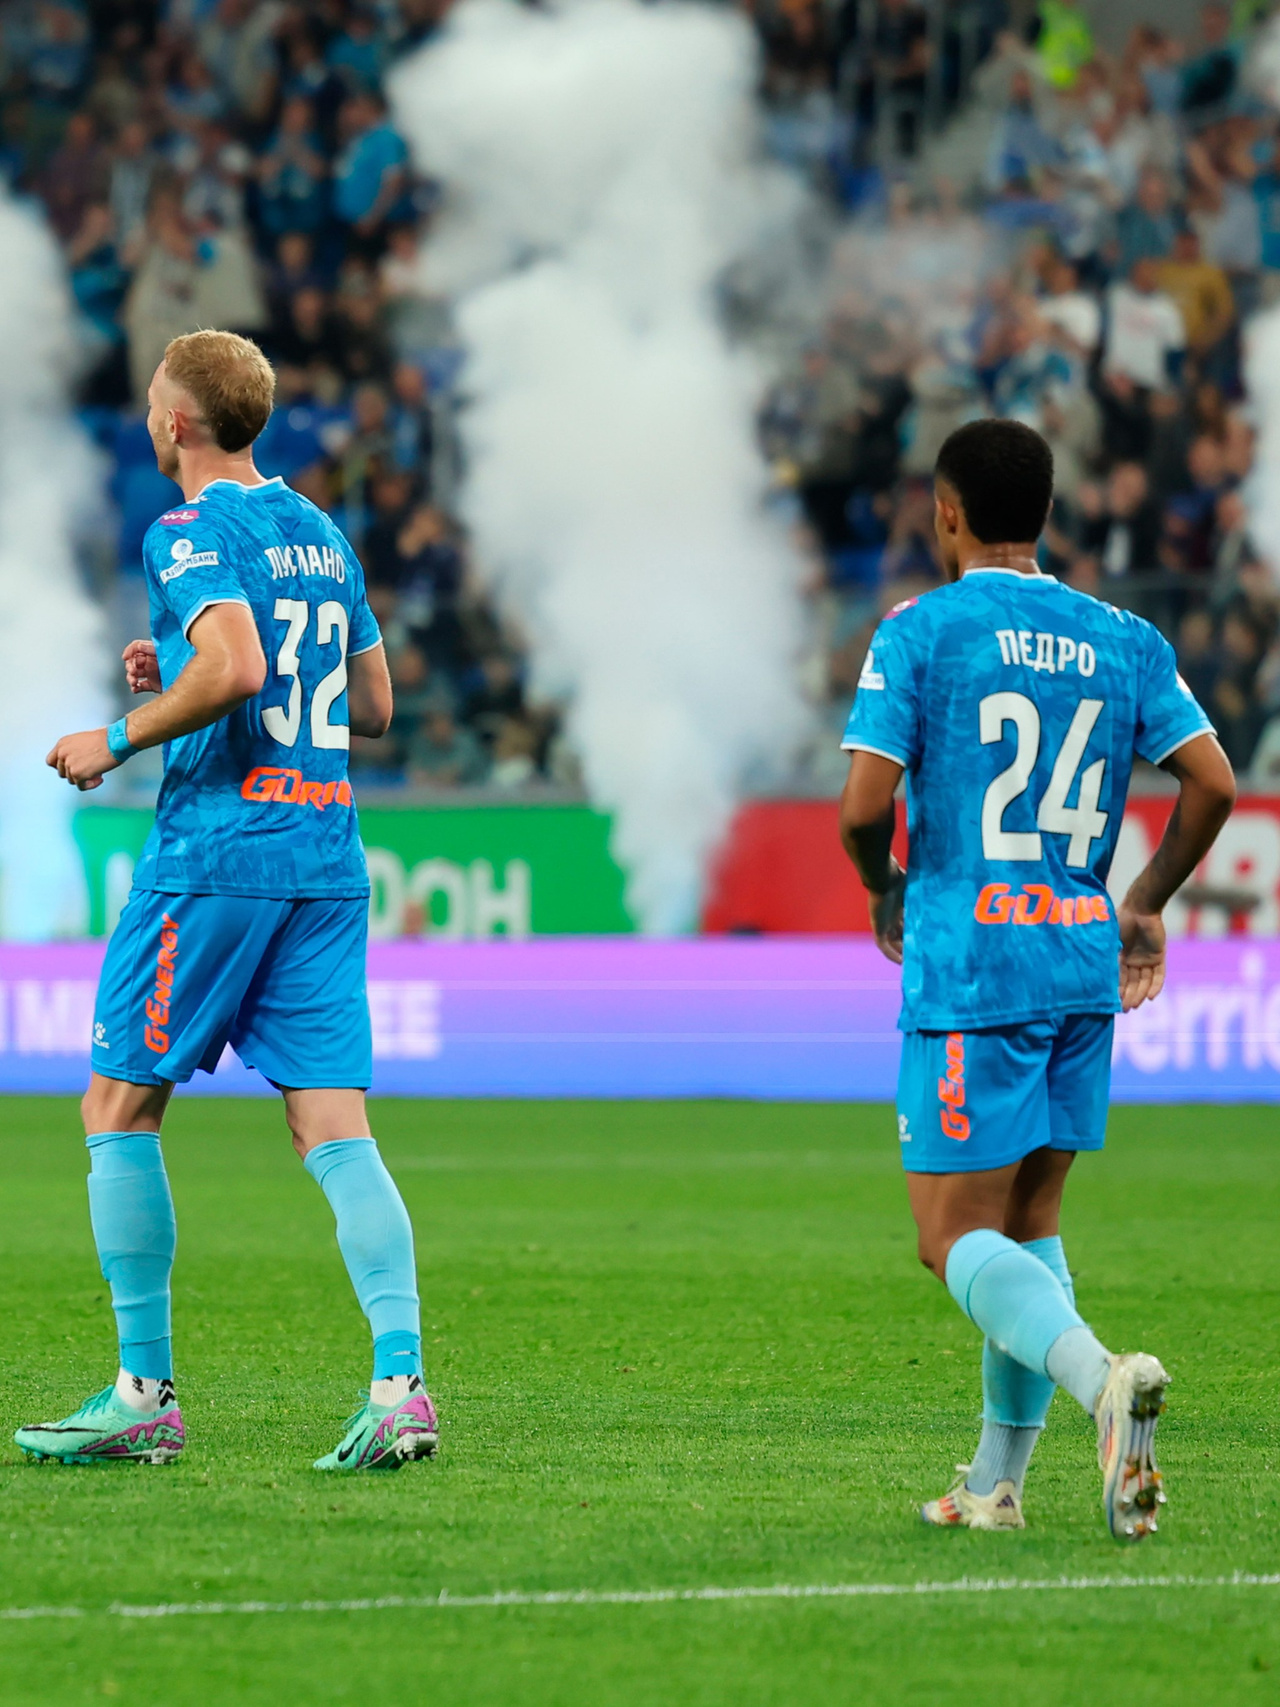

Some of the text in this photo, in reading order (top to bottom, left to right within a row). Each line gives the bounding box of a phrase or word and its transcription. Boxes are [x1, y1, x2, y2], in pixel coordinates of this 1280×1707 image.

[261, 599, 350, 750] 32
[996, 629, 1097, 678] ПЕДРО
[978, 691, 1109, 868] 24
